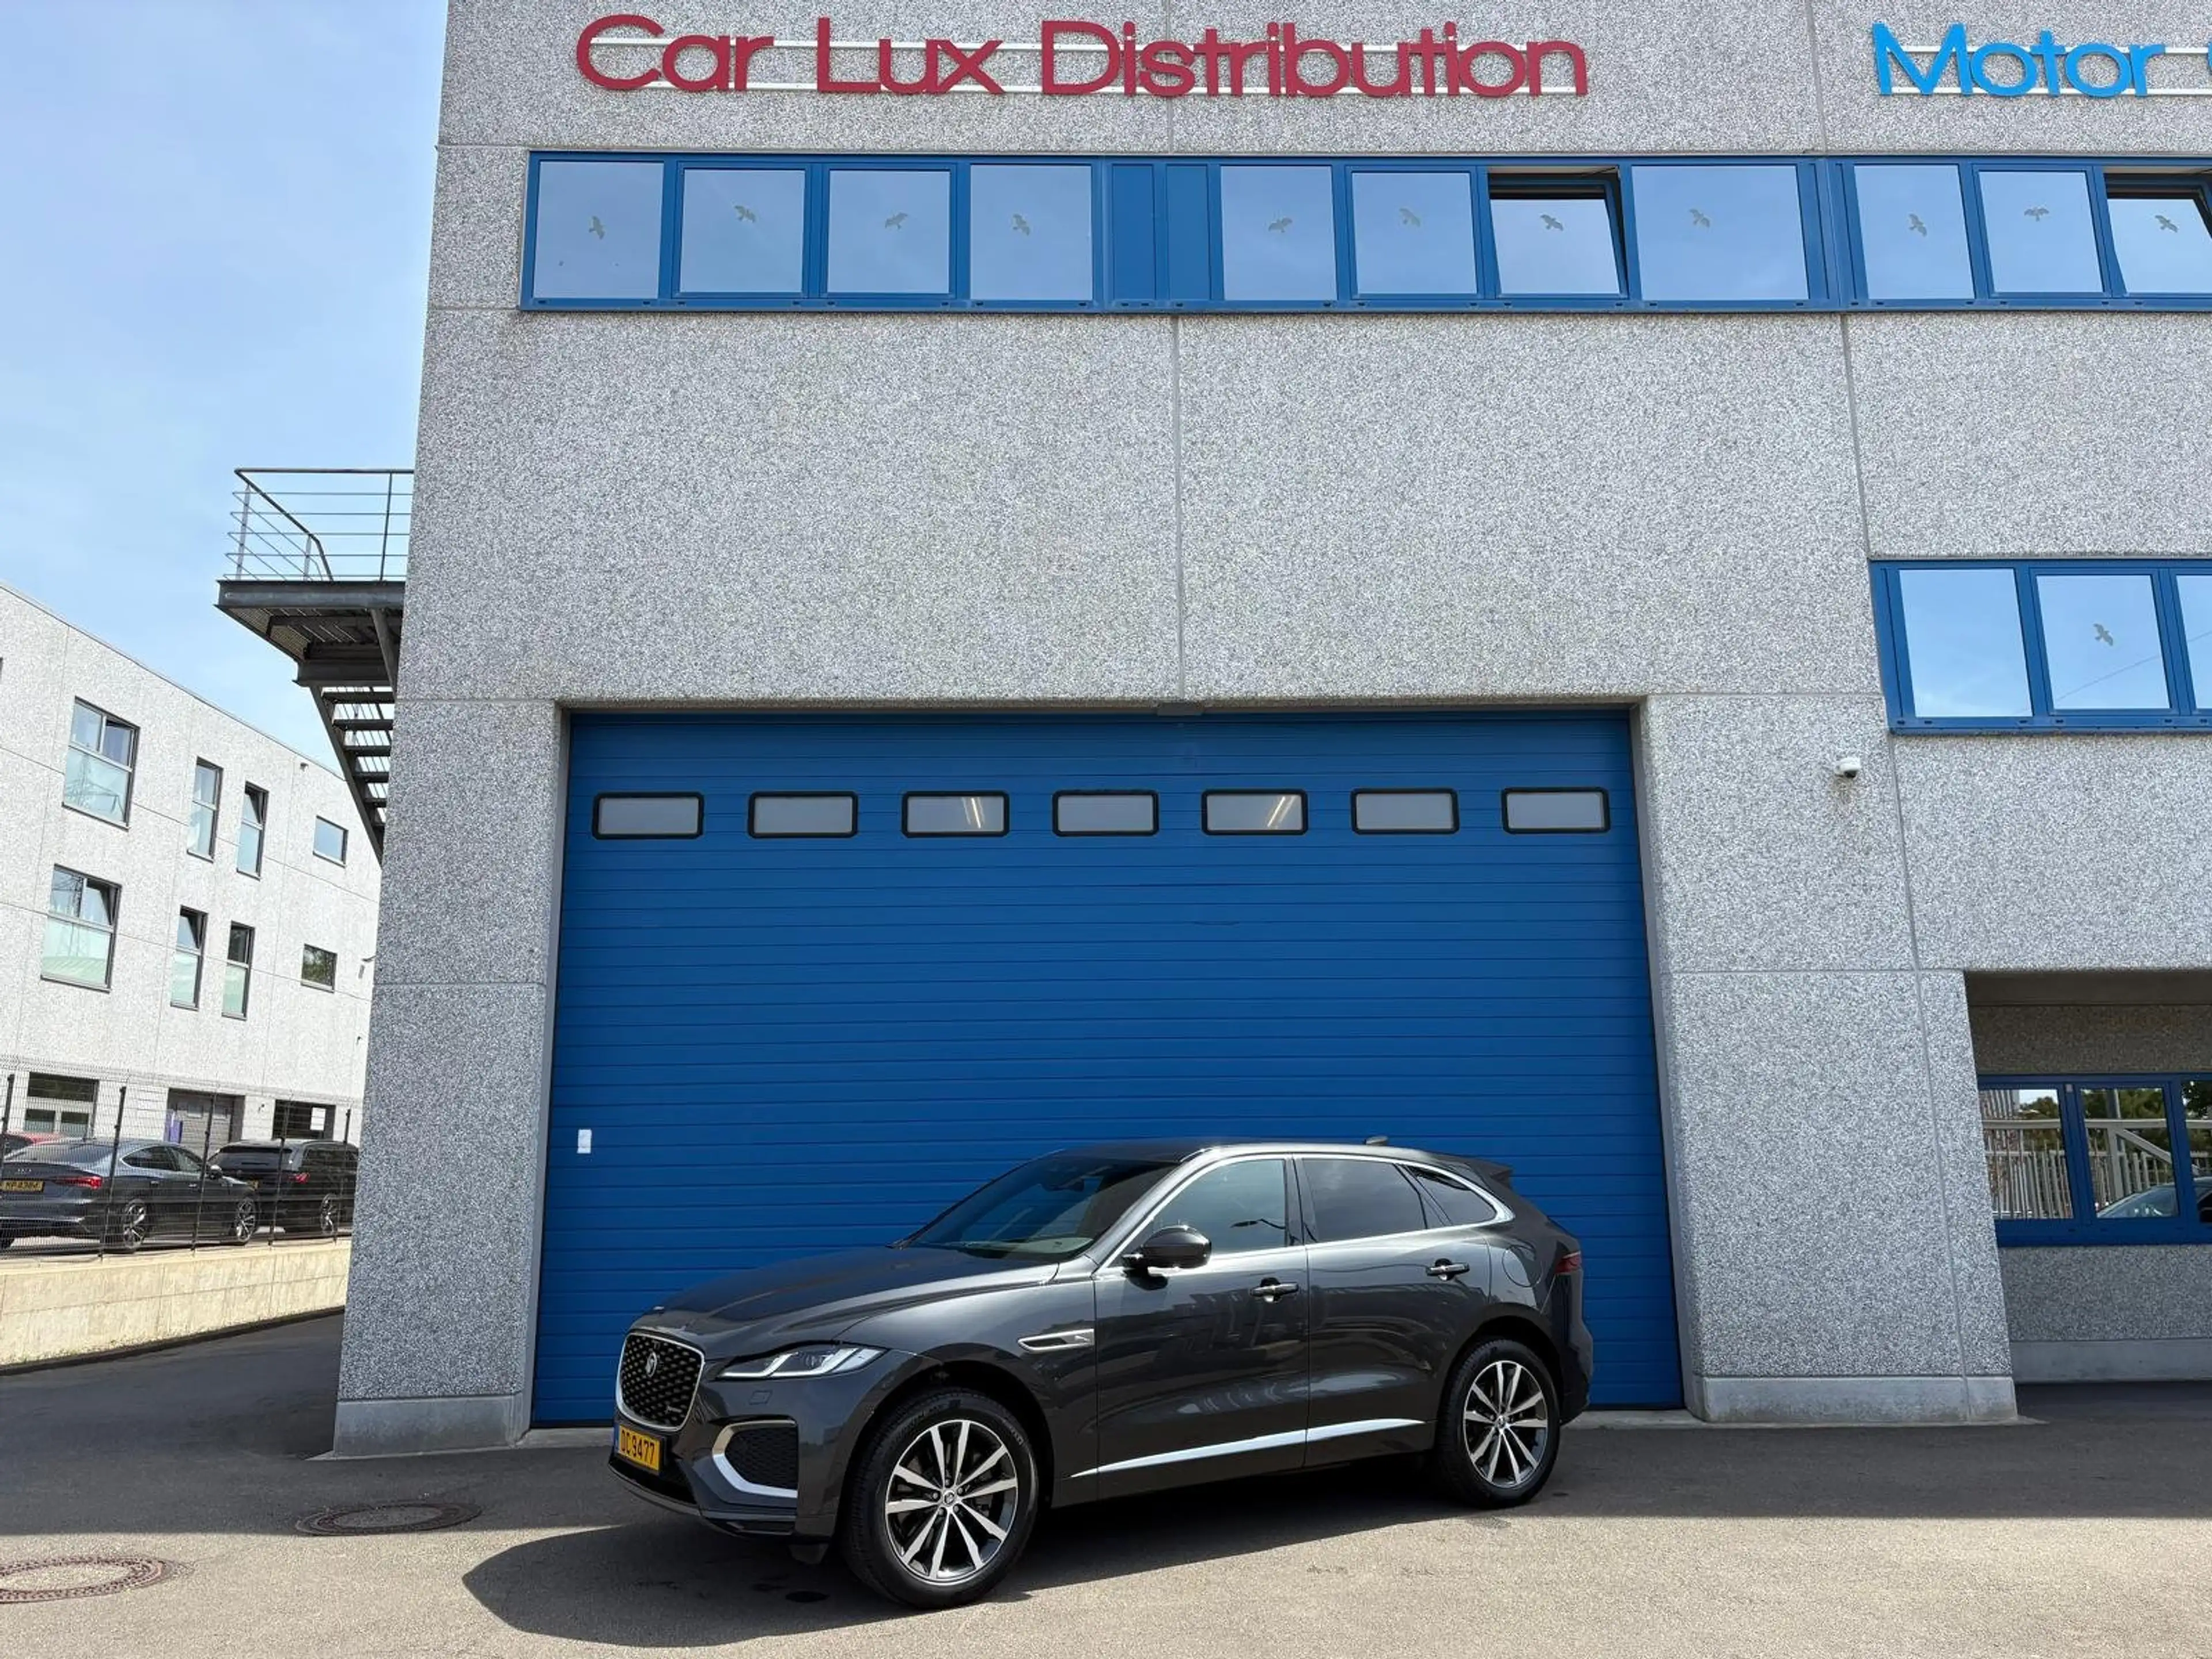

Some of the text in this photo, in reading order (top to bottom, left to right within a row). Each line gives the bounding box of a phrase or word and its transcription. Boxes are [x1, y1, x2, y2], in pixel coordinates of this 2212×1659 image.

[577, 14, 1588, 97] Car Lux Distribution
[1872, 22, 2165, 97] Motor
